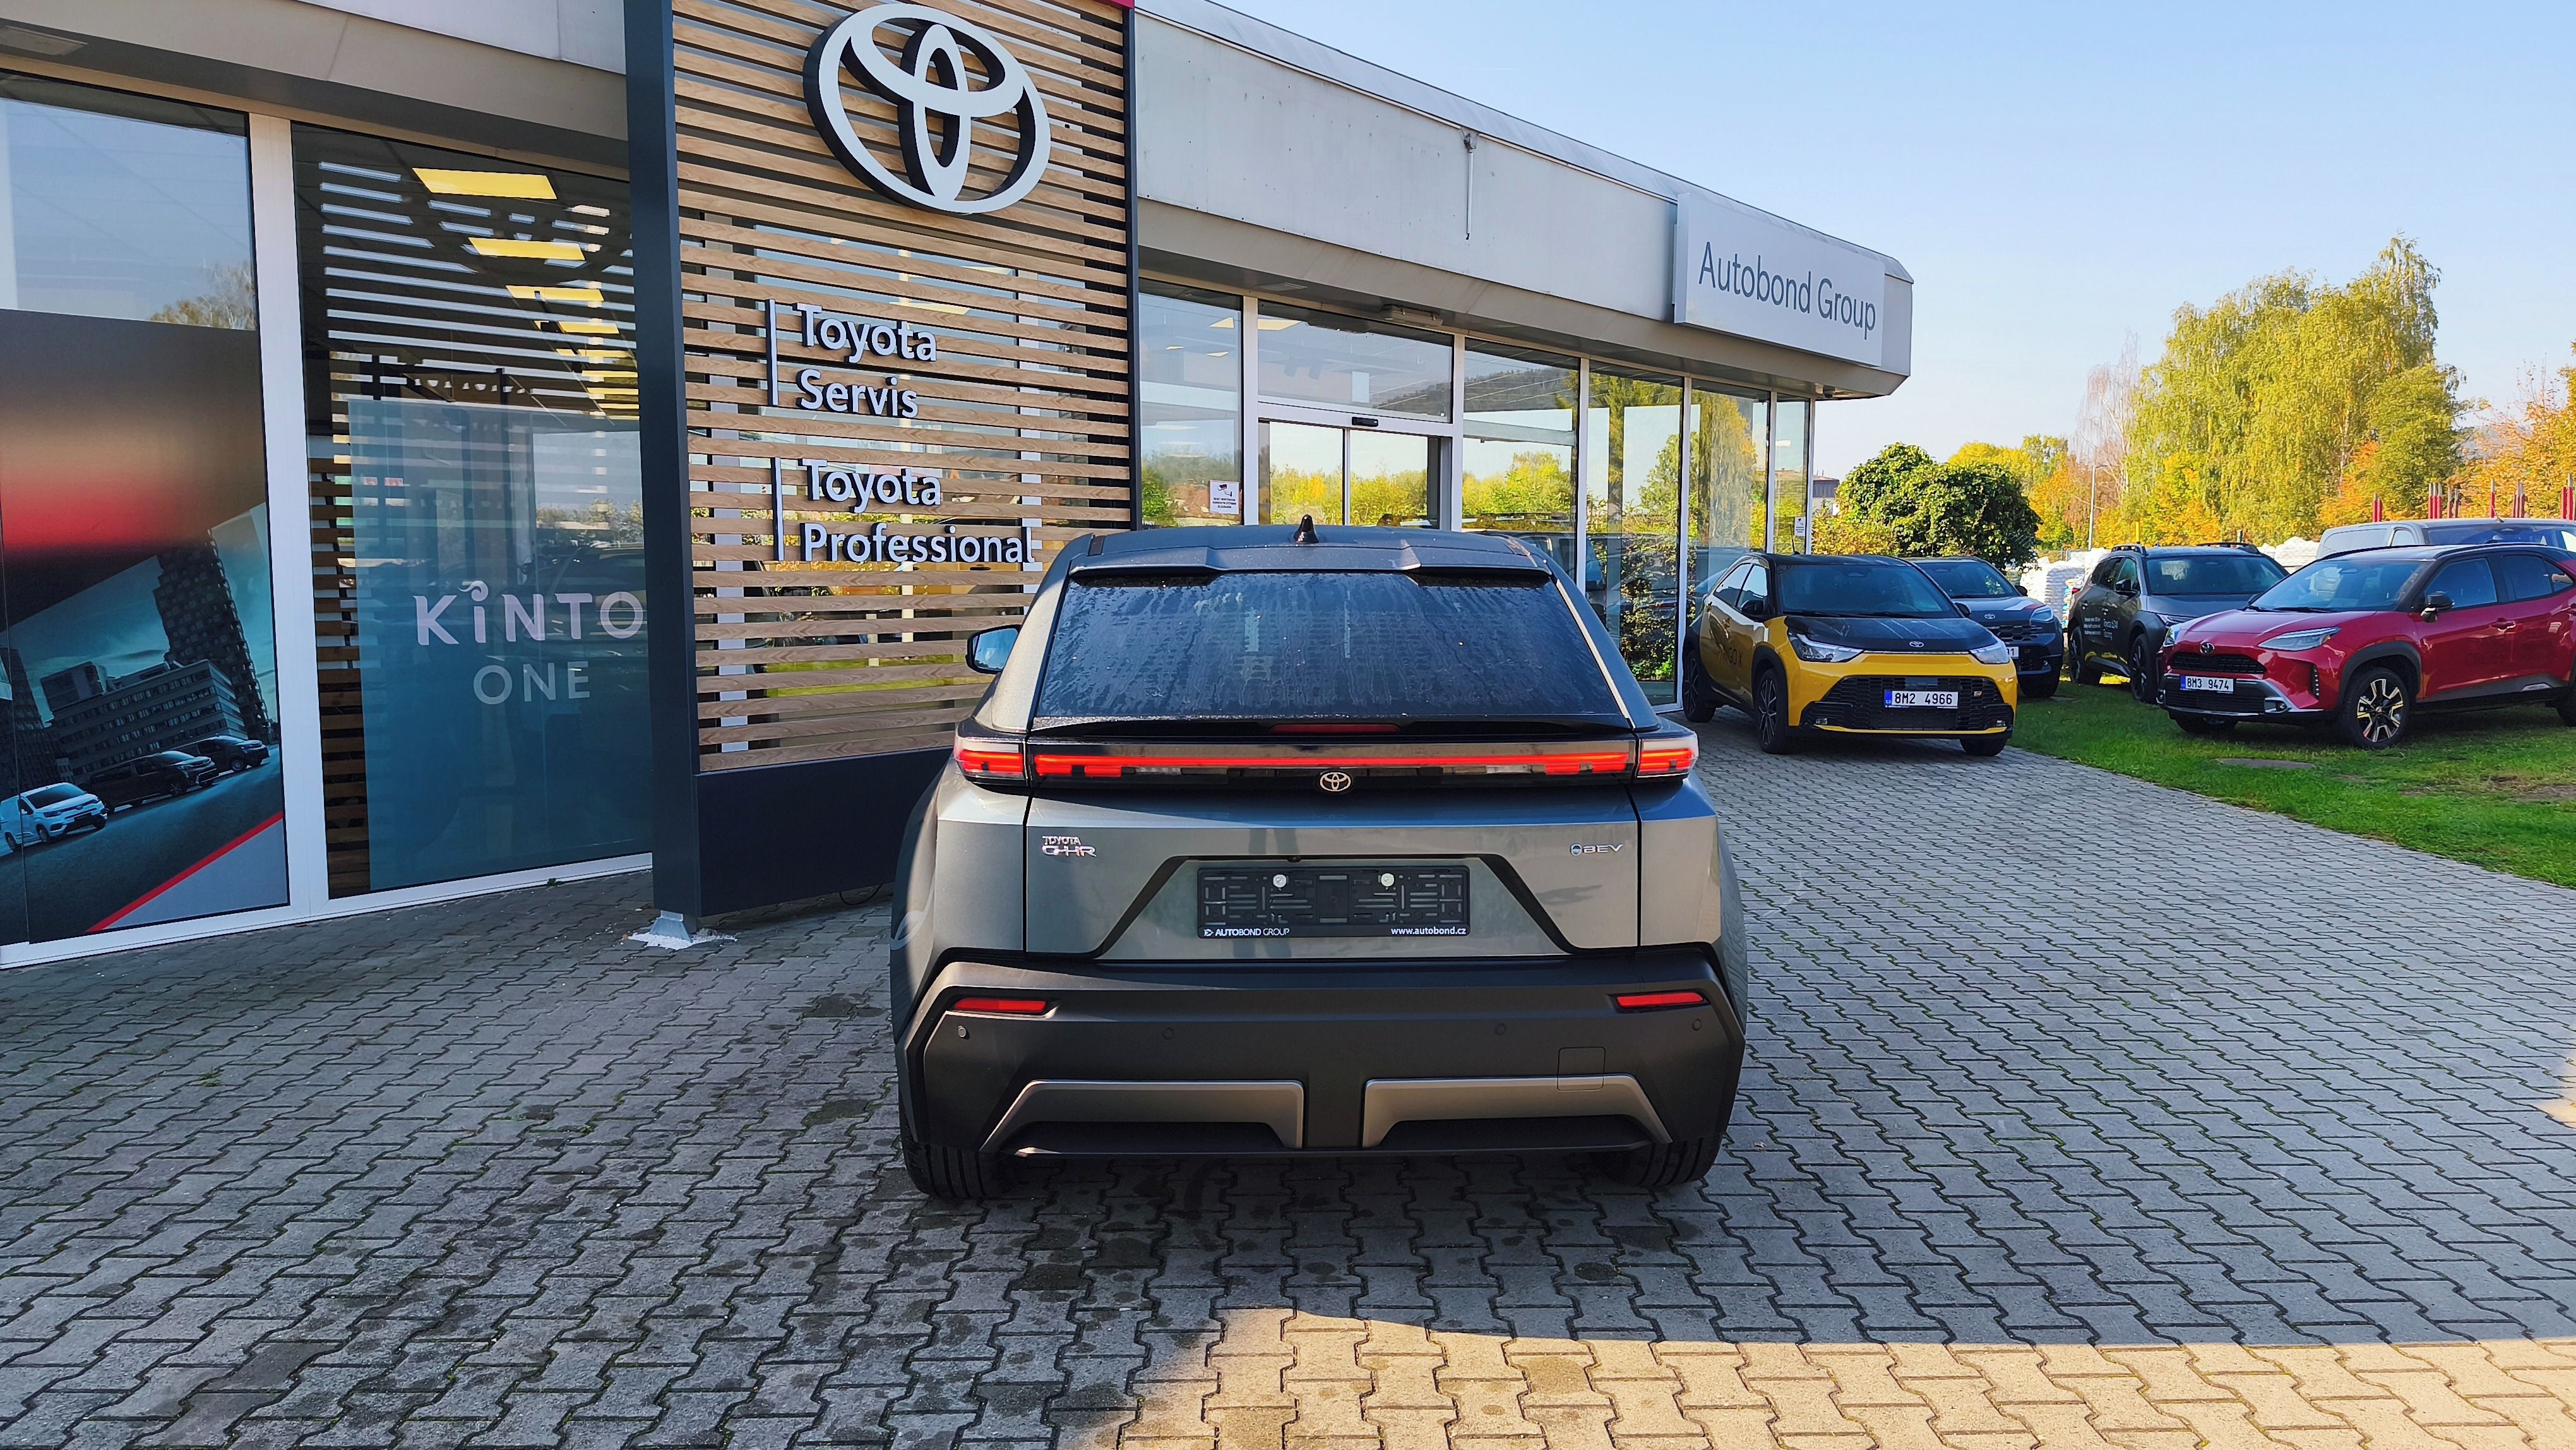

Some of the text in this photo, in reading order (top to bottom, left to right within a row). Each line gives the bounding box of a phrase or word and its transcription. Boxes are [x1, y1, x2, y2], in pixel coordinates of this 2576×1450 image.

[1699, 241, 1876, 340] Autobond Group
[794, 303, 937, 364] Toyota
[796, 369, 919, 419] Servis
[799, 458, 941, 513] Toyota
[801, 522, 1035, 563] Professional
[473, 661, 590, 705] ONE
[1895, 693, 1953, 705] 8M2 4966
[2187, 678, 2229, 690] 8M3 9474
[1042, 836, 1082, 845] TOYOTA
[1583, 844, 1623, 853] BEV
[1391, 926, 1467, 935] www.autobond.cz
